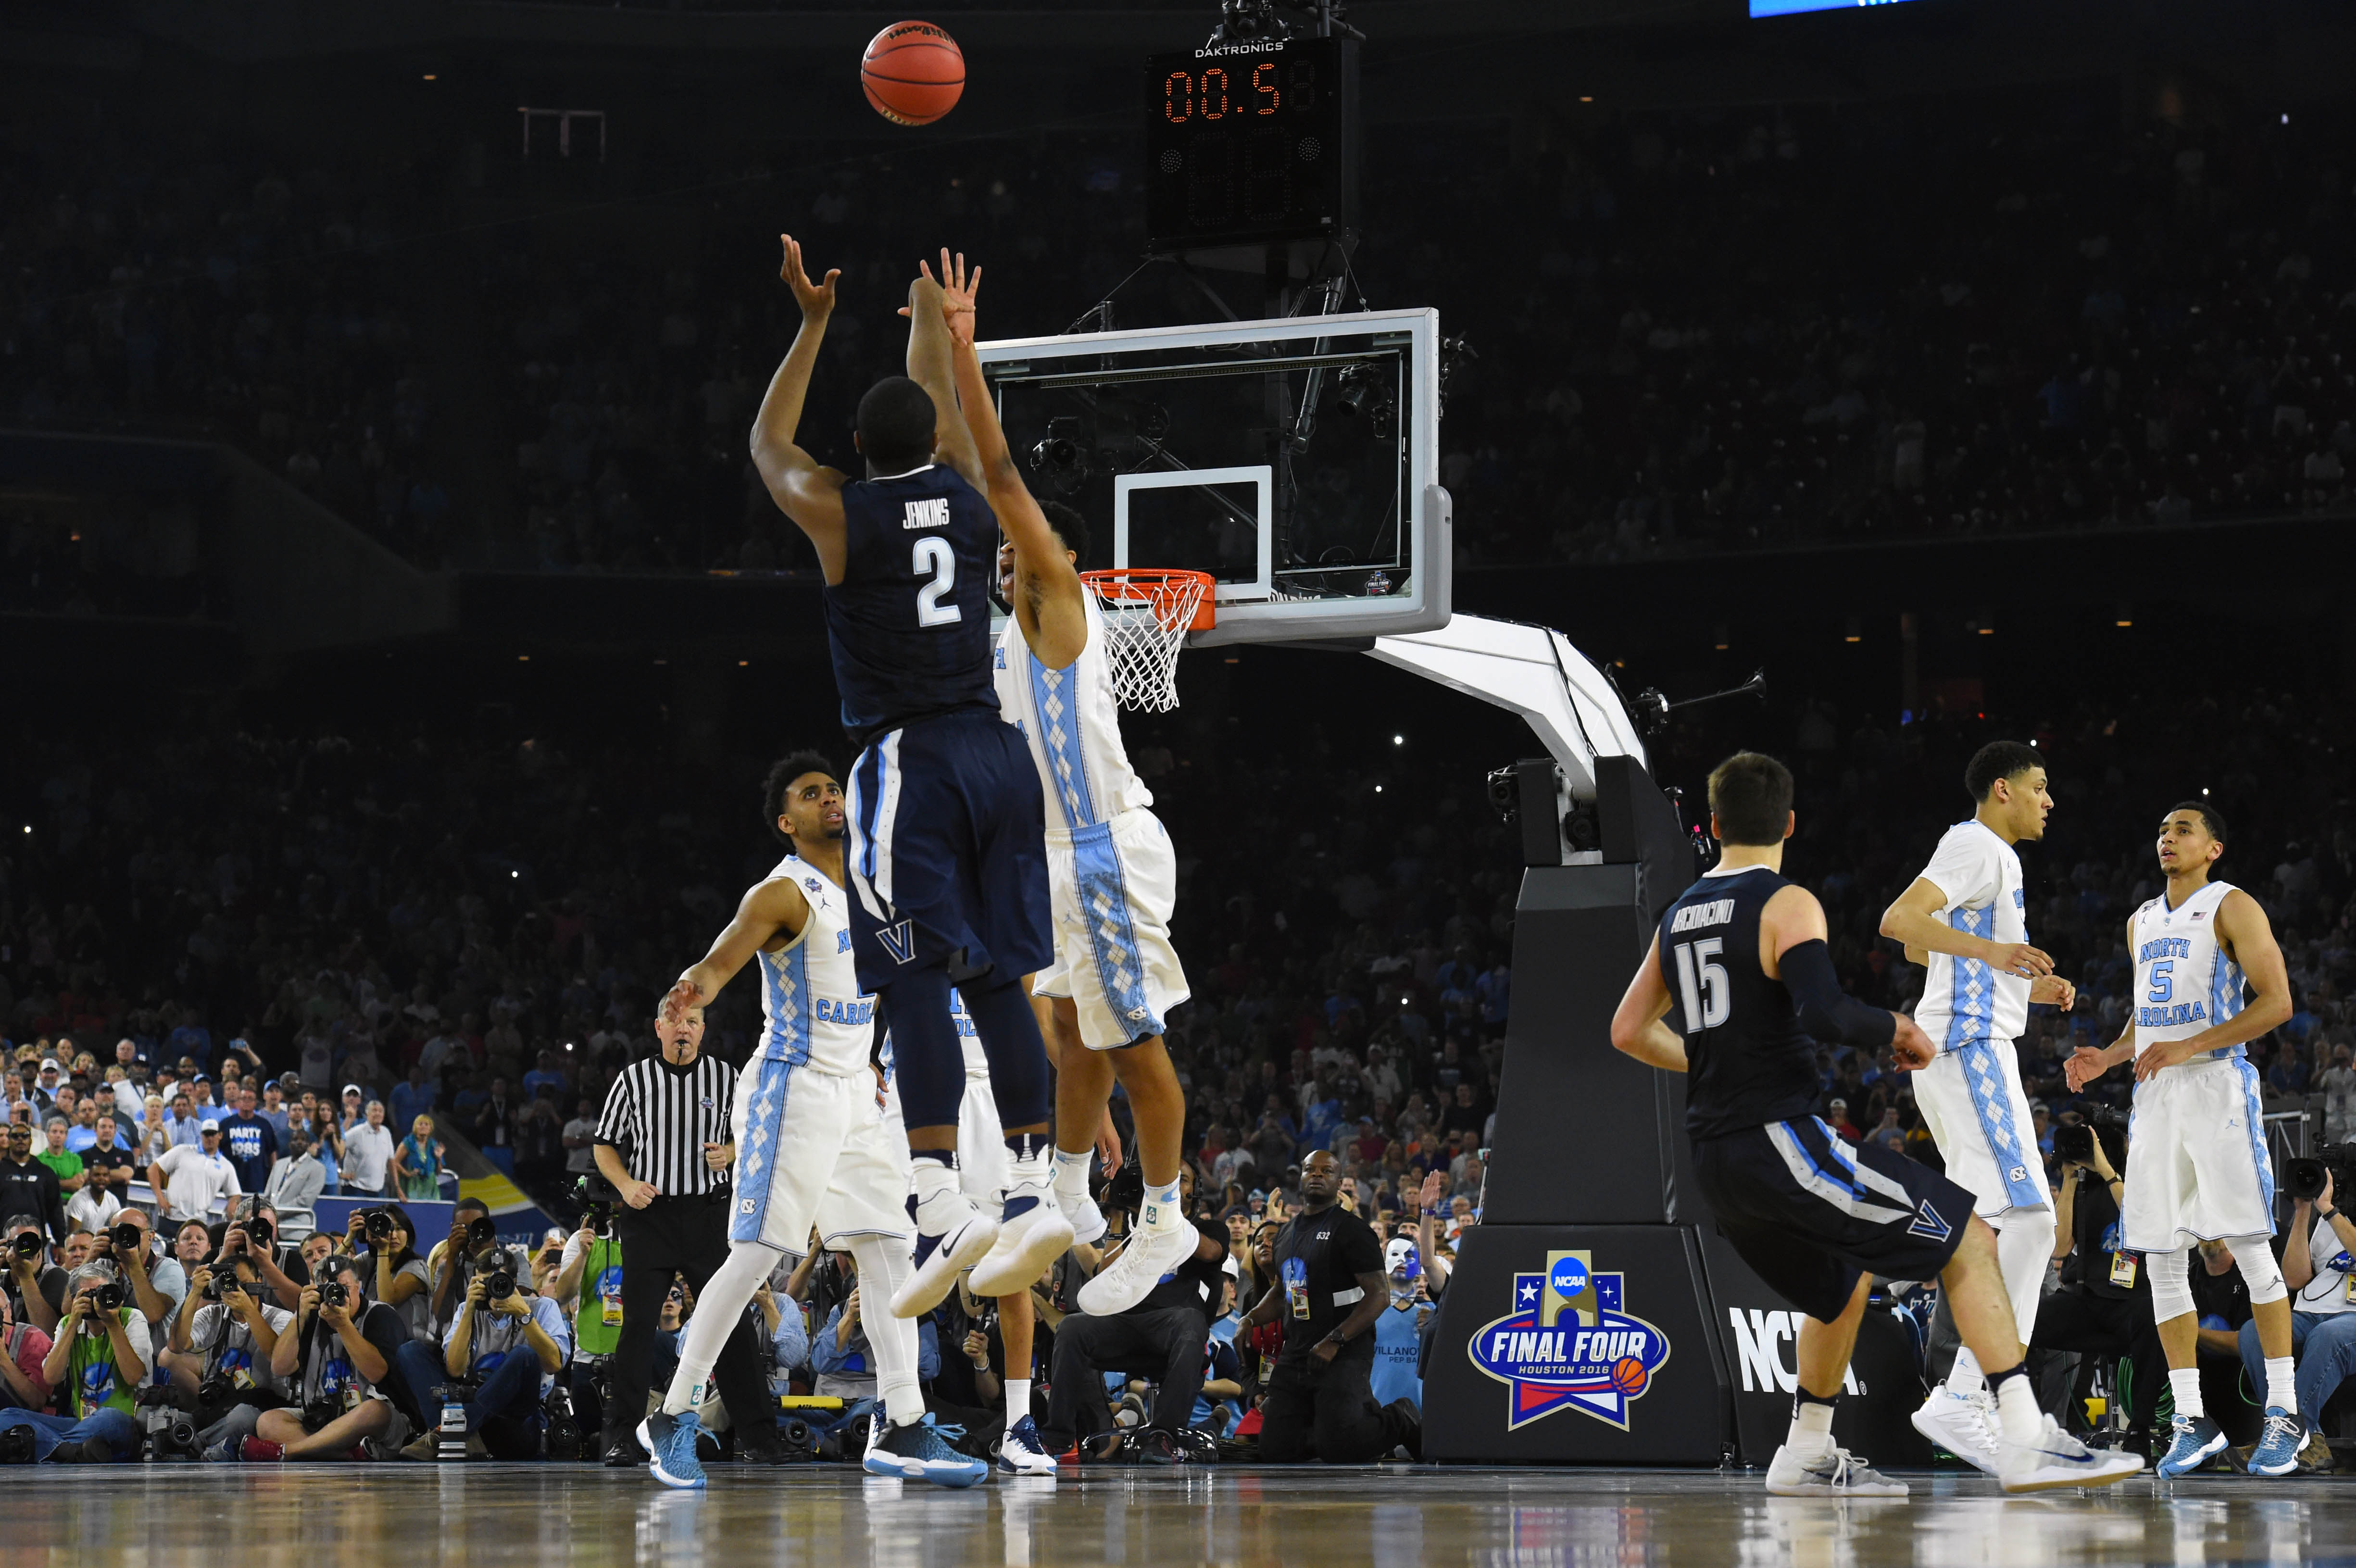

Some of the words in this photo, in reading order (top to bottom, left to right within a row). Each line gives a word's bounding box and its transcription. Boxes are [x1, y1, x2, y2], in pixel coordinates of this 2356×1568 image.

[1195, 42, 1284, 58] DAKTRONICS
[1166, 63, 1279, 123] 00.5
[903, 498, 950, 529] JENKINS
[913, 536, 962, 627] 2
[1671, 899, 1735, 934] ARCIDIACONO
[2140, 938, 2191, 964] NORTH
[1674, 937, 1730, 1033] 15
[2148, 960, 2173, 1002] 5
[816, 999, 875, 1025] CAROL
[2134, 1001, 2206, 1027] AROLINA
[229, 1128, 262, 1139] PARTY
[231, 1142, 260, 1156] 1985
[1316, 1231, 1331, 1240] 632
[1554, 1276, 1586, 1287] NCAA
[1374, 1346, 1419, 1356] VILLANO
[1491, 1332, 1566, 1362] FINAL
[1573, 1331, 1647, 1362] FOUR
[1518, 1366, 1575, 1374] HOUSTON
[1578, 1366, 1609, 1374] 2016
